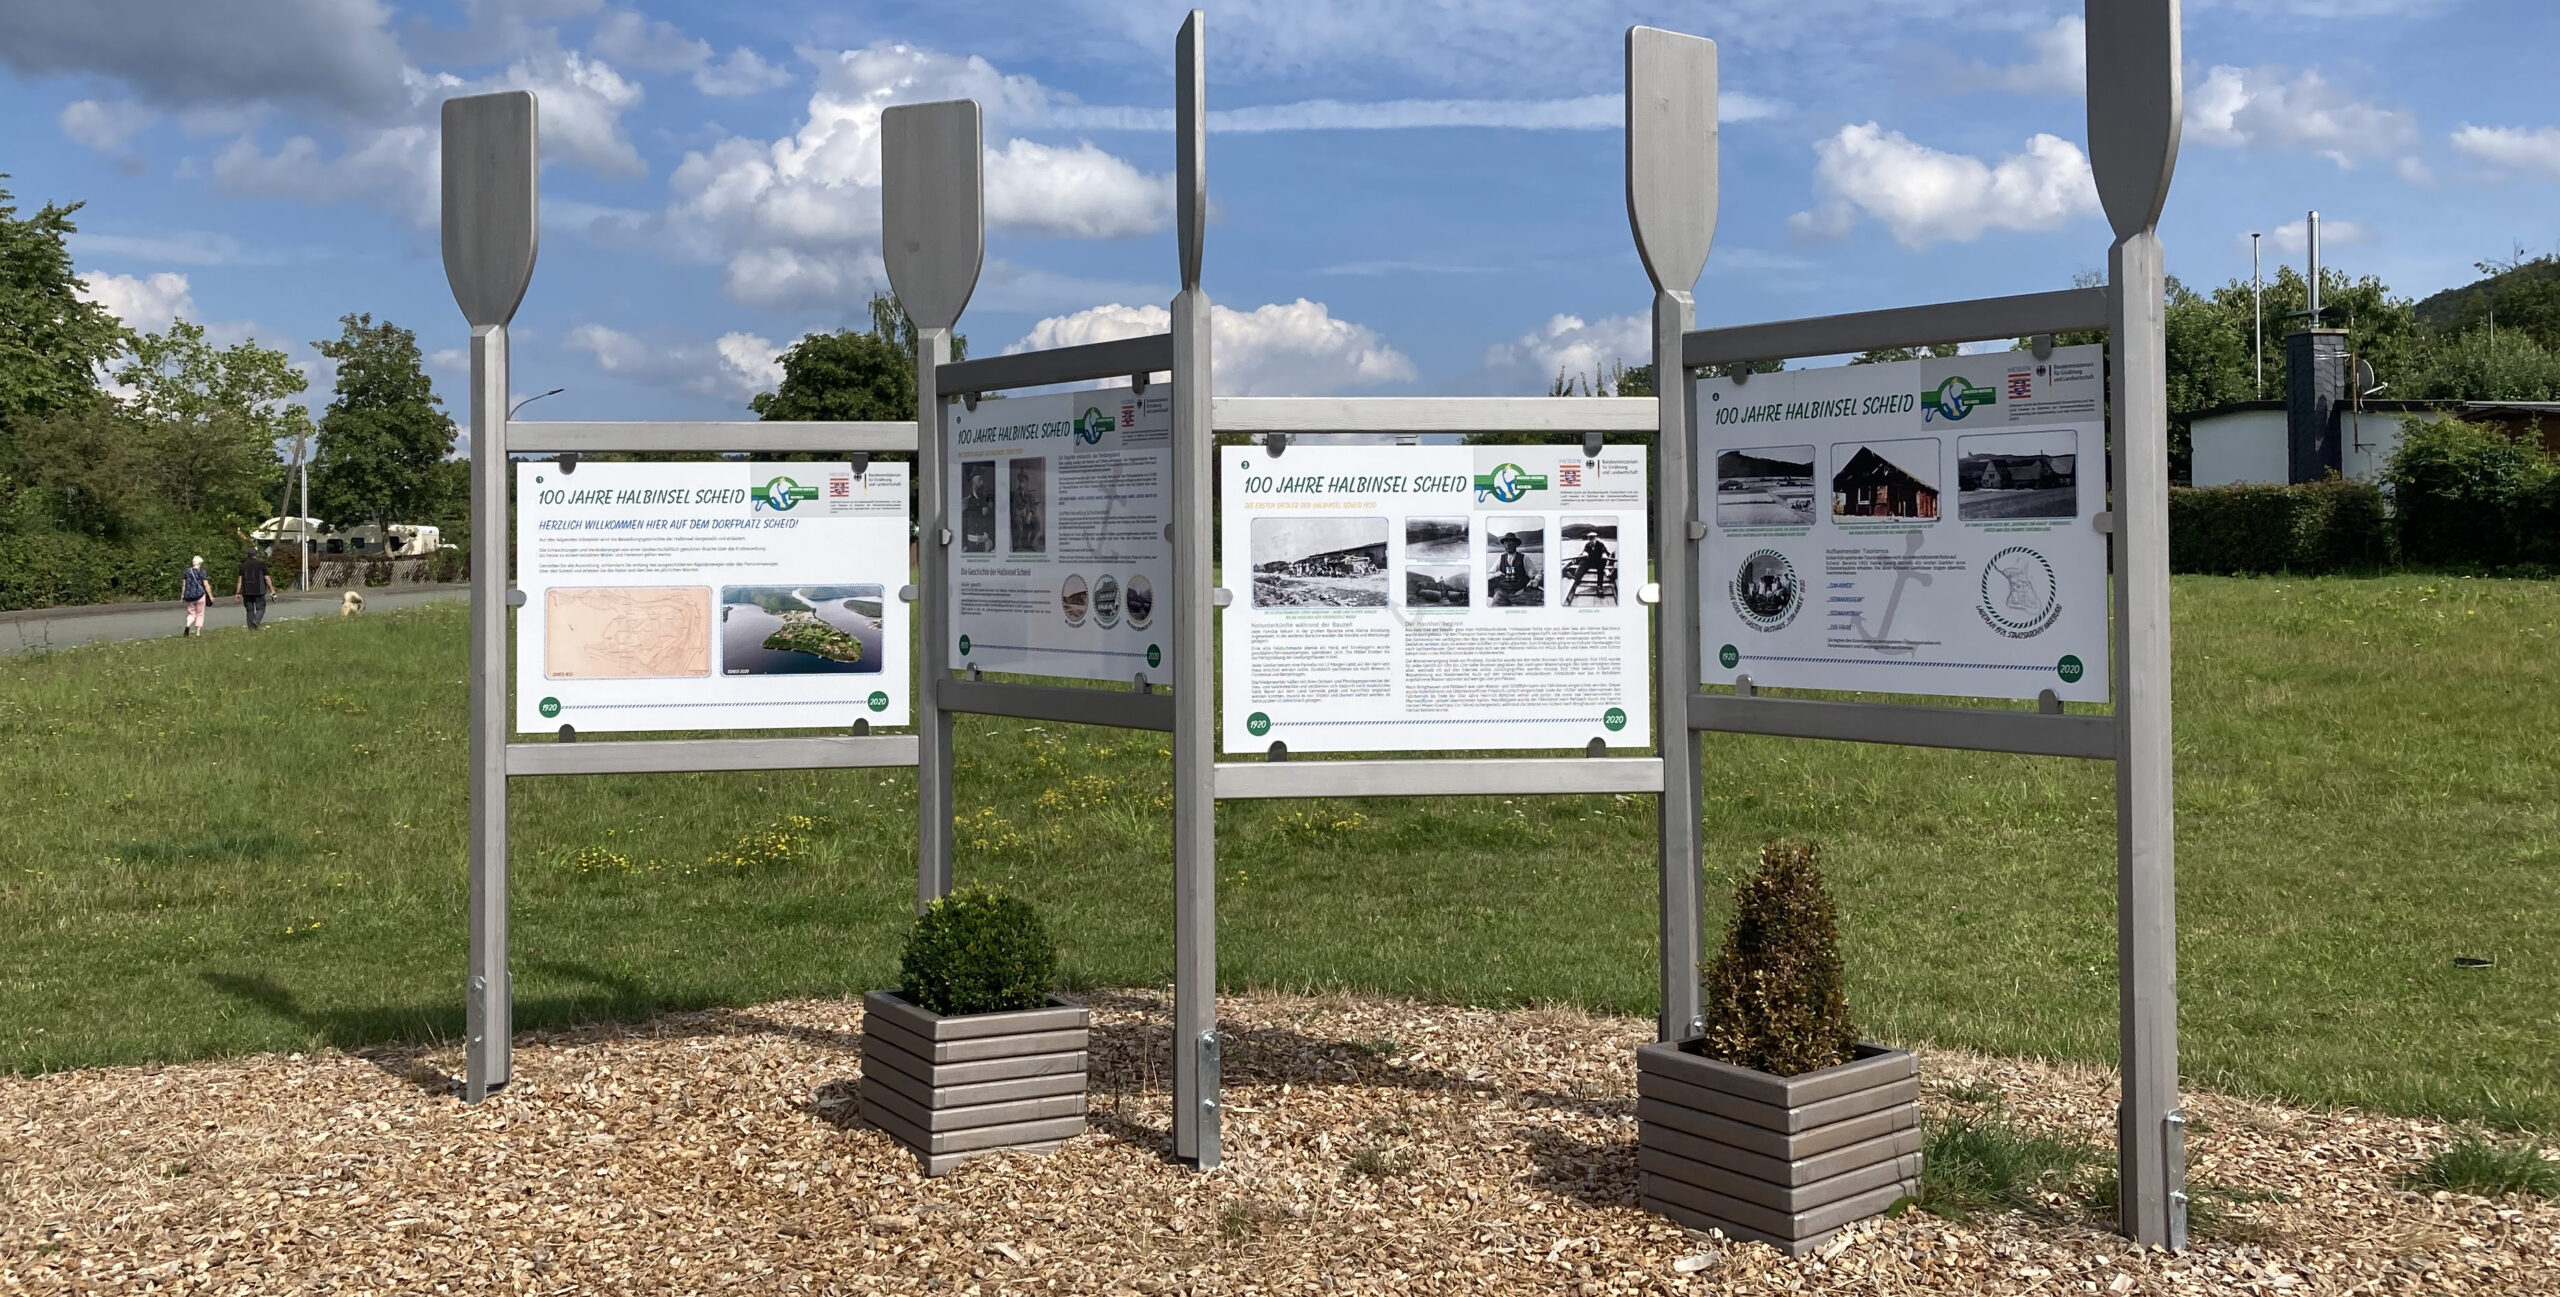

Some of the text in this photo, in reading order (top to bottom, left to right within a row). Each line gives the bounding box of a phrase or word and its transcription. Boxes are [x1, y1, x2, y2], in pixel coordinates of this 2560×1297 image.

[1716, 394, 1914, 425] 100 JAHRE HALBINSEL SCHEID
[958, 420, 1071, 444] 100 JAHRE HALBINSEL SCHEID
[1244, 476, 1468, 494] 100 JAHRE HALBINSEL SCHEID
[539, 489, 745, 505] 100 JAHRE HALBINSEL SCHEID
[539, 518, 799, 530] HERZLICH WILLKOMMEN HIER AUF DEM DORFPLATZ SCHEID!
[968, 568, 989, 576] Geschichte
[997, 568, 1016, 576] Halbinsel
[1017, 568, 1031, 576] Scheid
[1976, 605, 1997, 629] LAGEPLAN
[1148, 652, 1160, 660] 2020
[1722, 652, 1736, 660] 1920
[2060, 665, 2081, 674] 2020
[870, 697, 886, 706] 2020
[542, 703, 558, 712] 1920
[1606, 715, 1624, 724] 2020
[1250, 720, 1266, 729] 1920
